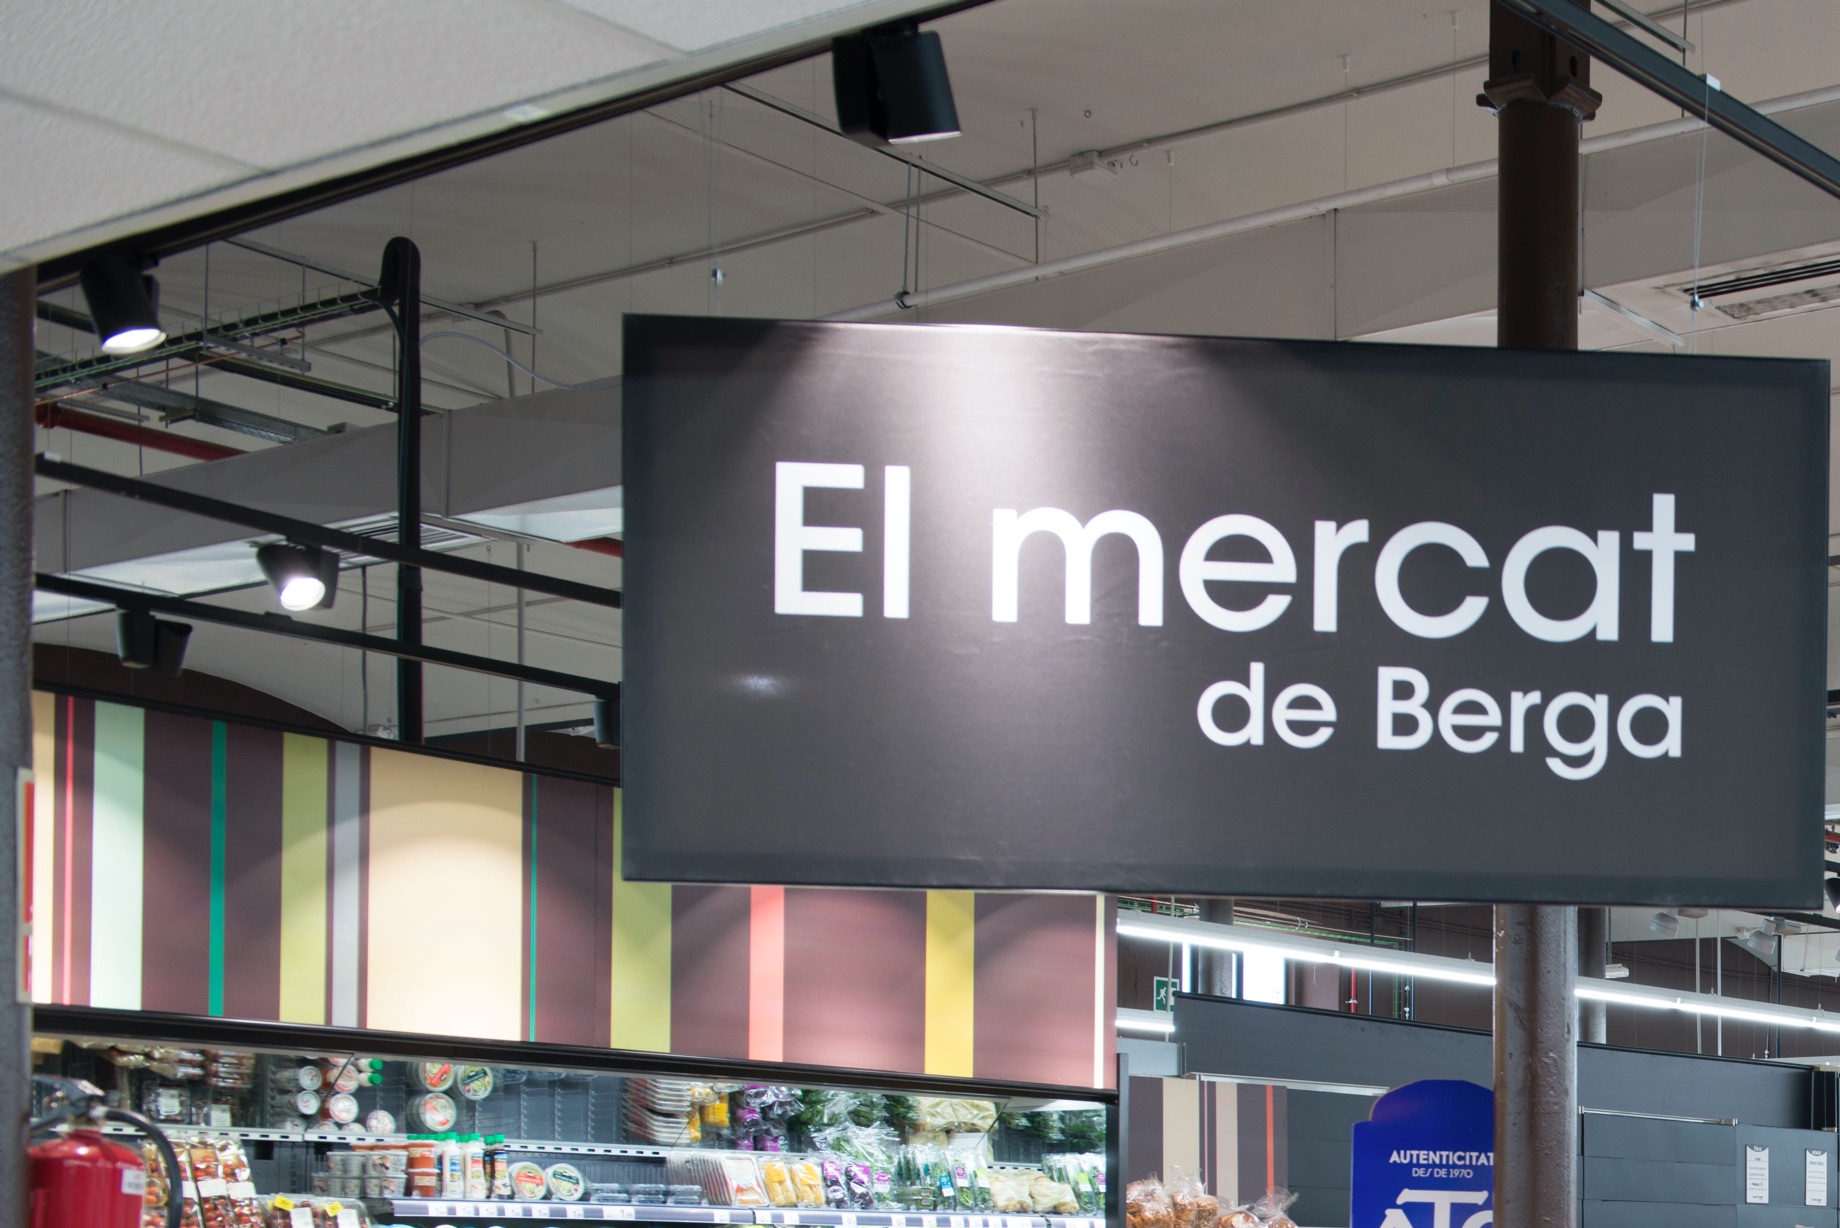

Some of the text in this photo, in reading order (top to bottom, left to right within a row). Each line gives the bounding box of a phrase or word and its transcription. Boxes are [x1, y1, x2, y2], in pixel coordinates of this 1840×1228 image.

[774, 461, 1695, 643] El mercat
[1196, 662, 1683, 781] de Berga
[1389, 1150, 1495, 1166] AUTENTICITAT
[1434, 1168, 1448, 1178] DE
[1449, 1168, 1474, 1178] 1970
